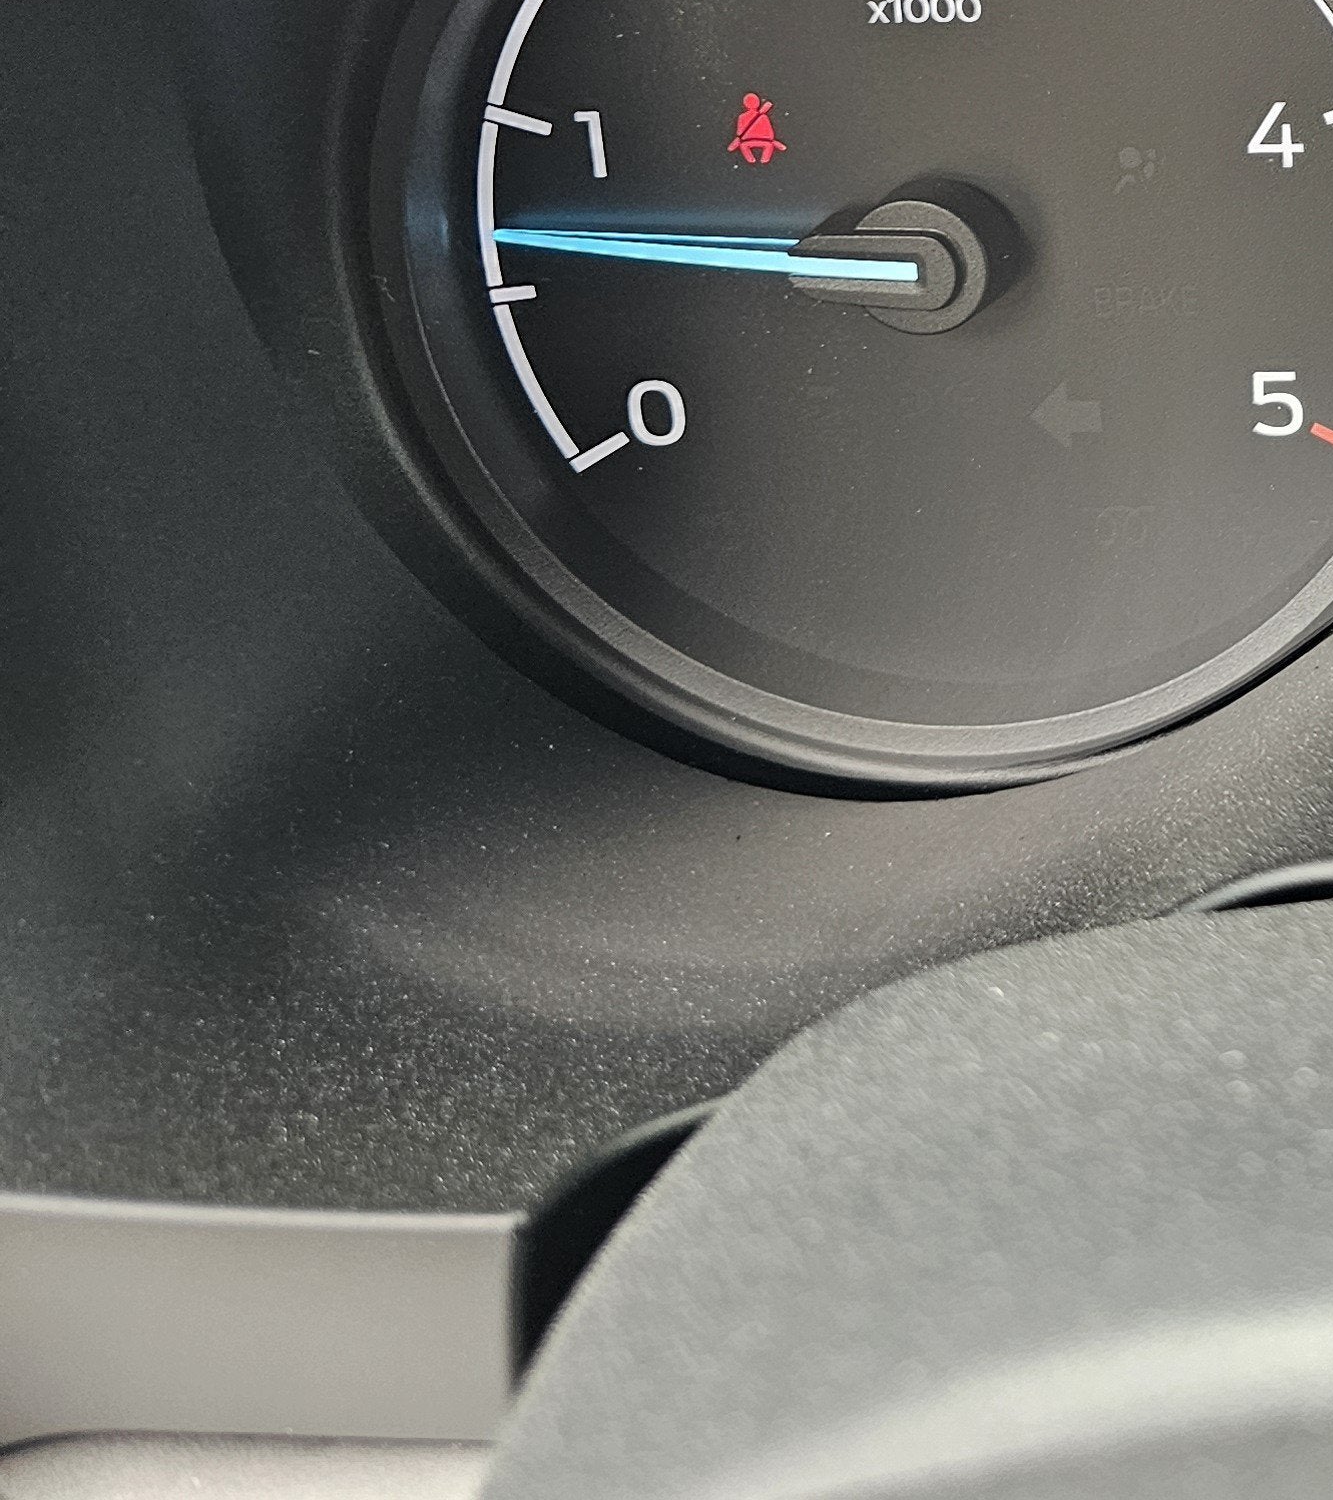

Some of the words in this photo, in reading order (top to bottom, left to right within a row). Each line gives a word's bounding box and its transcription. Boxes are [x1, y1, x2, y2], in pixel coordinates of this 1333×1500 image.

[573, 110, 608, 178] 1
[1247, 101, 1305, 168] 4
[626, 379, 687, 447] 0
[1252, 371, 1304, 437] 5
